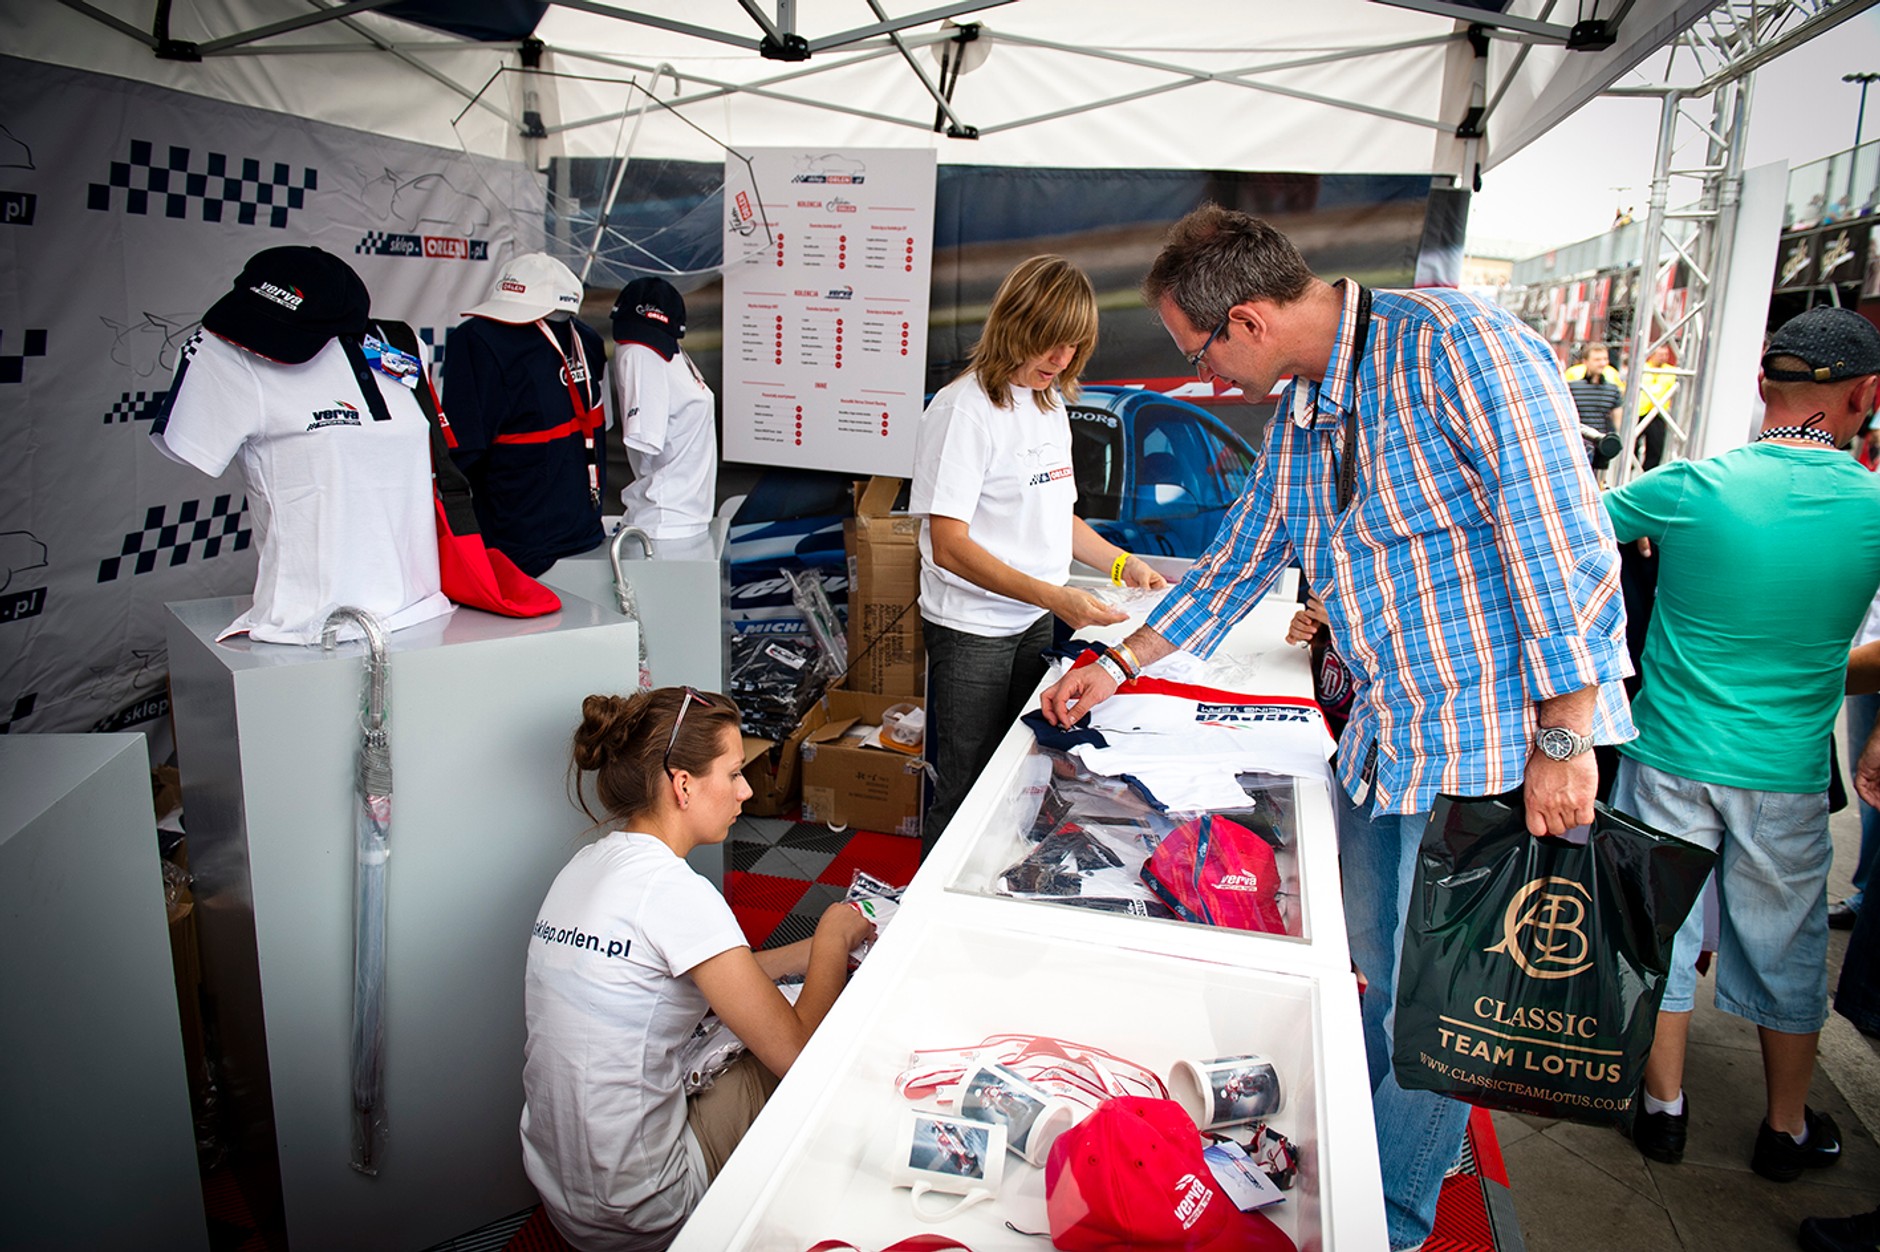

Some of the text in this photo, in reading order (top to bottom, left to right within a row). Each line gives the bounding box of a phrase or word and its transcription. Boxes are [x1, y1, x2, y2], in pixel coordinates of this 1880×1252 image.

[427, 240, 466, 258] ORLEN
[260, 282, 303, 306] verva
[312, 409, 360, 421] verva
[1069, 411, 1118, 429] DORS
[124, 699, 169, 724] sklep
[1220, 874, 1257, 886] verva
[1474, 996, 1598, 1039] CLASSIC
[1438, 1027, 1621, 1084] TEAM LOTUS
[1174, 1178, 1206, 1222] verva
